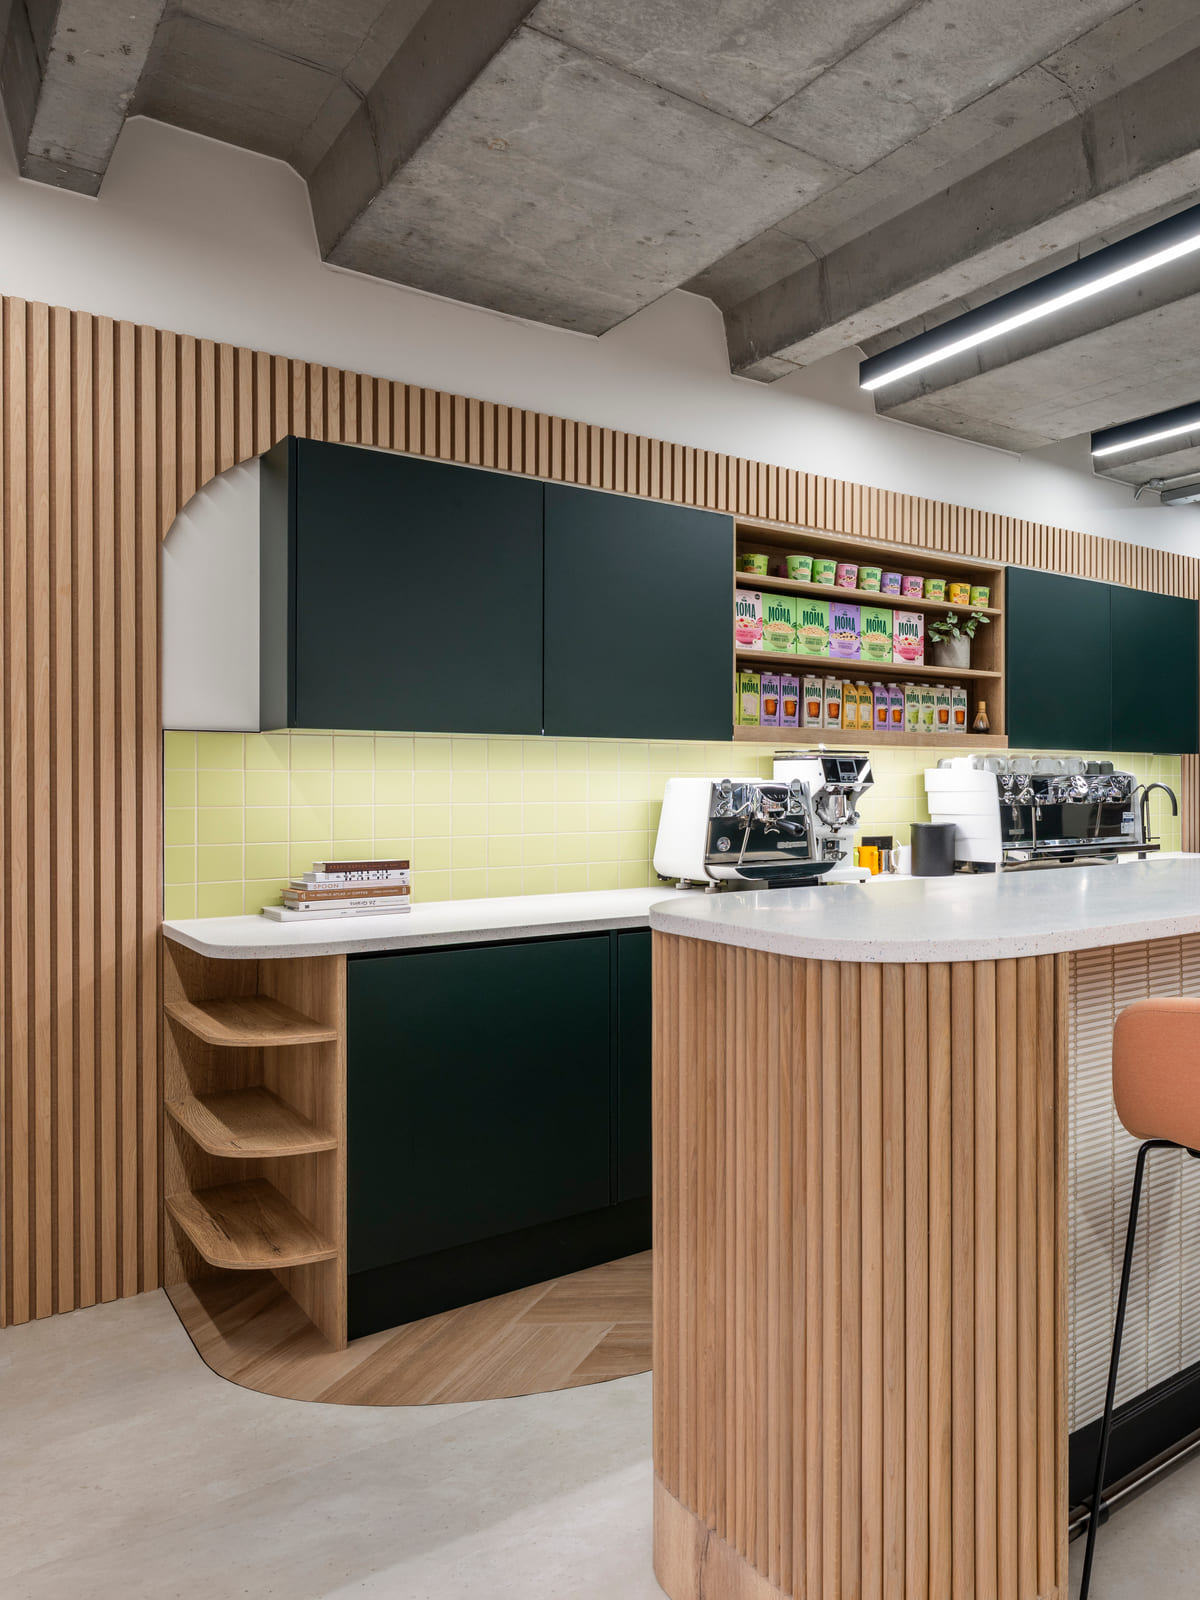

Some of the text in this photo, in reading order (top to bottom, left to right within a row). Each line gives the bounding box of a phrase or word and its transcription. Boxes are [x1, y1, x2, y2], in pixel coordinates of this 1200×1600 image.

[768, 606, 791, 625] MOMA
[803, 610, 824, 628] MOMA
[834, 615, 856, 633] MOMA
[866, 618, 887, 635] MOMA
[898, 622, 918, 639] MOMA
[742, 682, 759, 695] MOMA
[762, 683, 778, 697] MOMA
[782, 684, 798, 697] MOMA
[805, 686, 822, 699] MOMA
[826, 687, 842, 700] MOMA
[859, 695, 872, 705] MOMA
[906, 693, 920, 705] MOMA
[921, 694, 935, 705] MOMA
[936, 695, 950, 706] MOMA
[952, 696, 966, 707] MOMA
